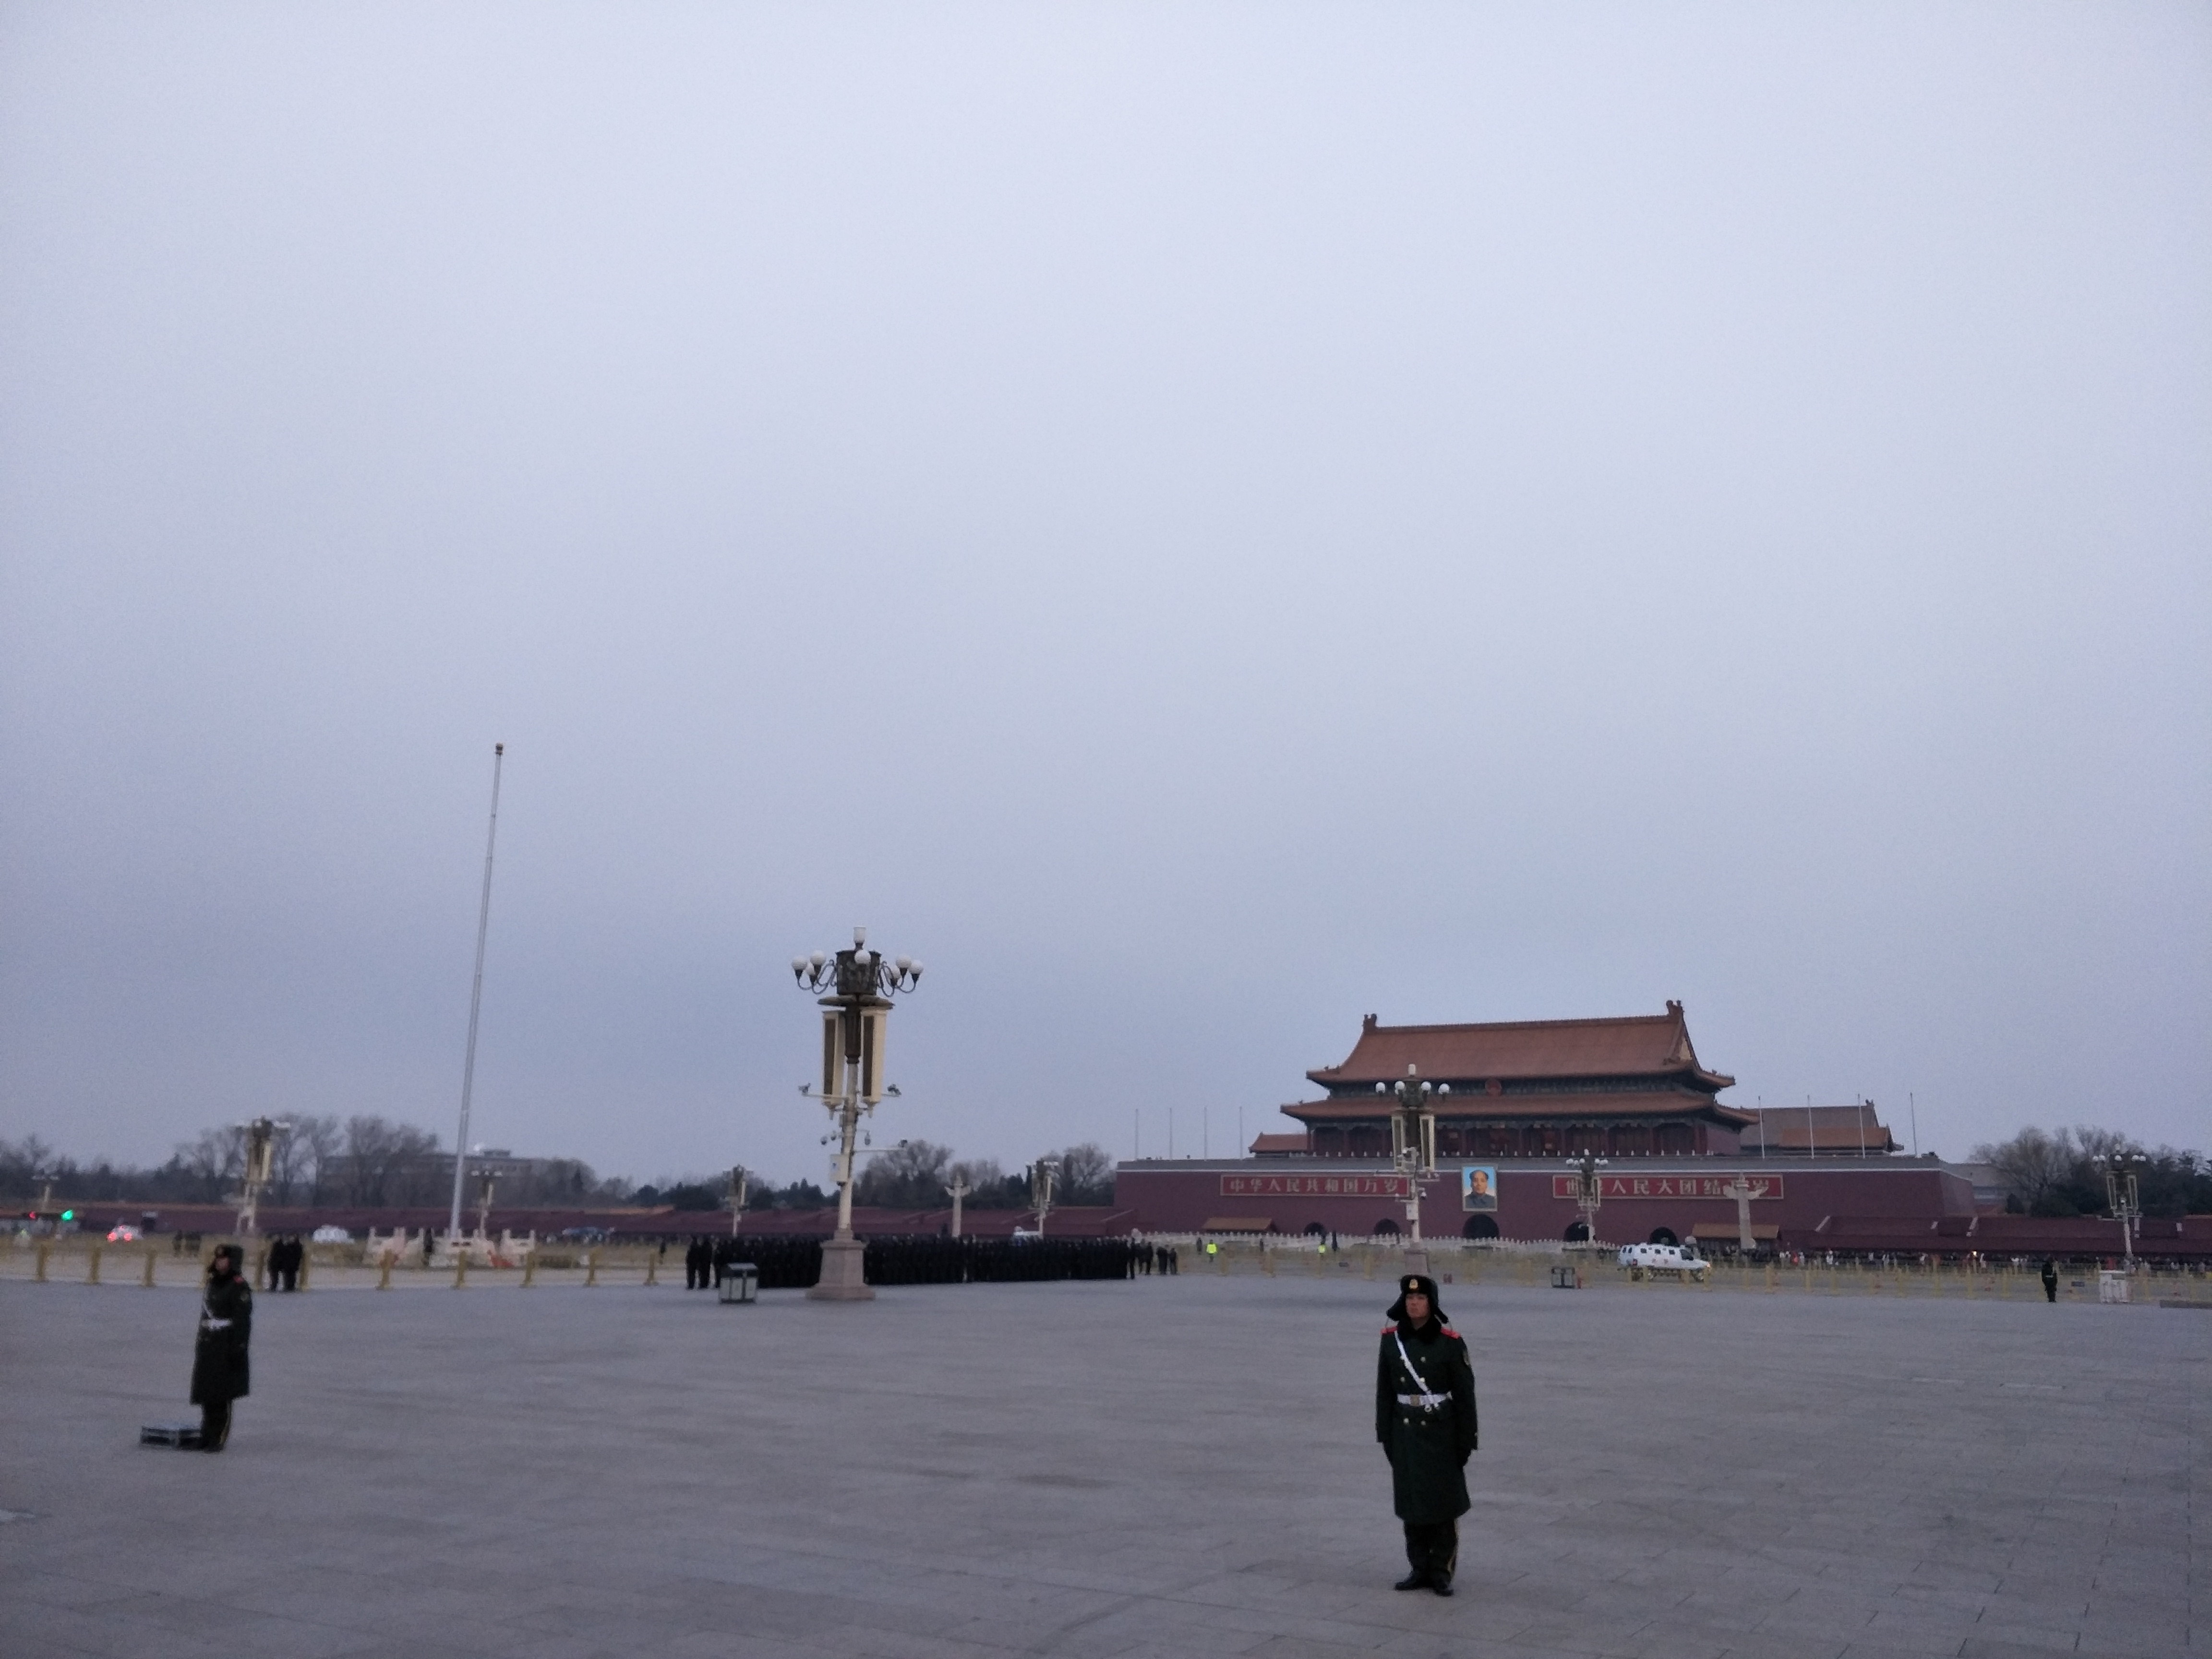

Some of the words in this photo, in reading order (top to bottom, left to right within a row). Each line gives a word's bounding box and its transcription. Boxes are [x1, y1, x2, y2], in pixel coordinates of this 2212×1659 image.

[1230, 1178, 1398, 1192] 中华人民共和国万岁
[1566, 1179, 1769, 1194] 世人民大团结岁
